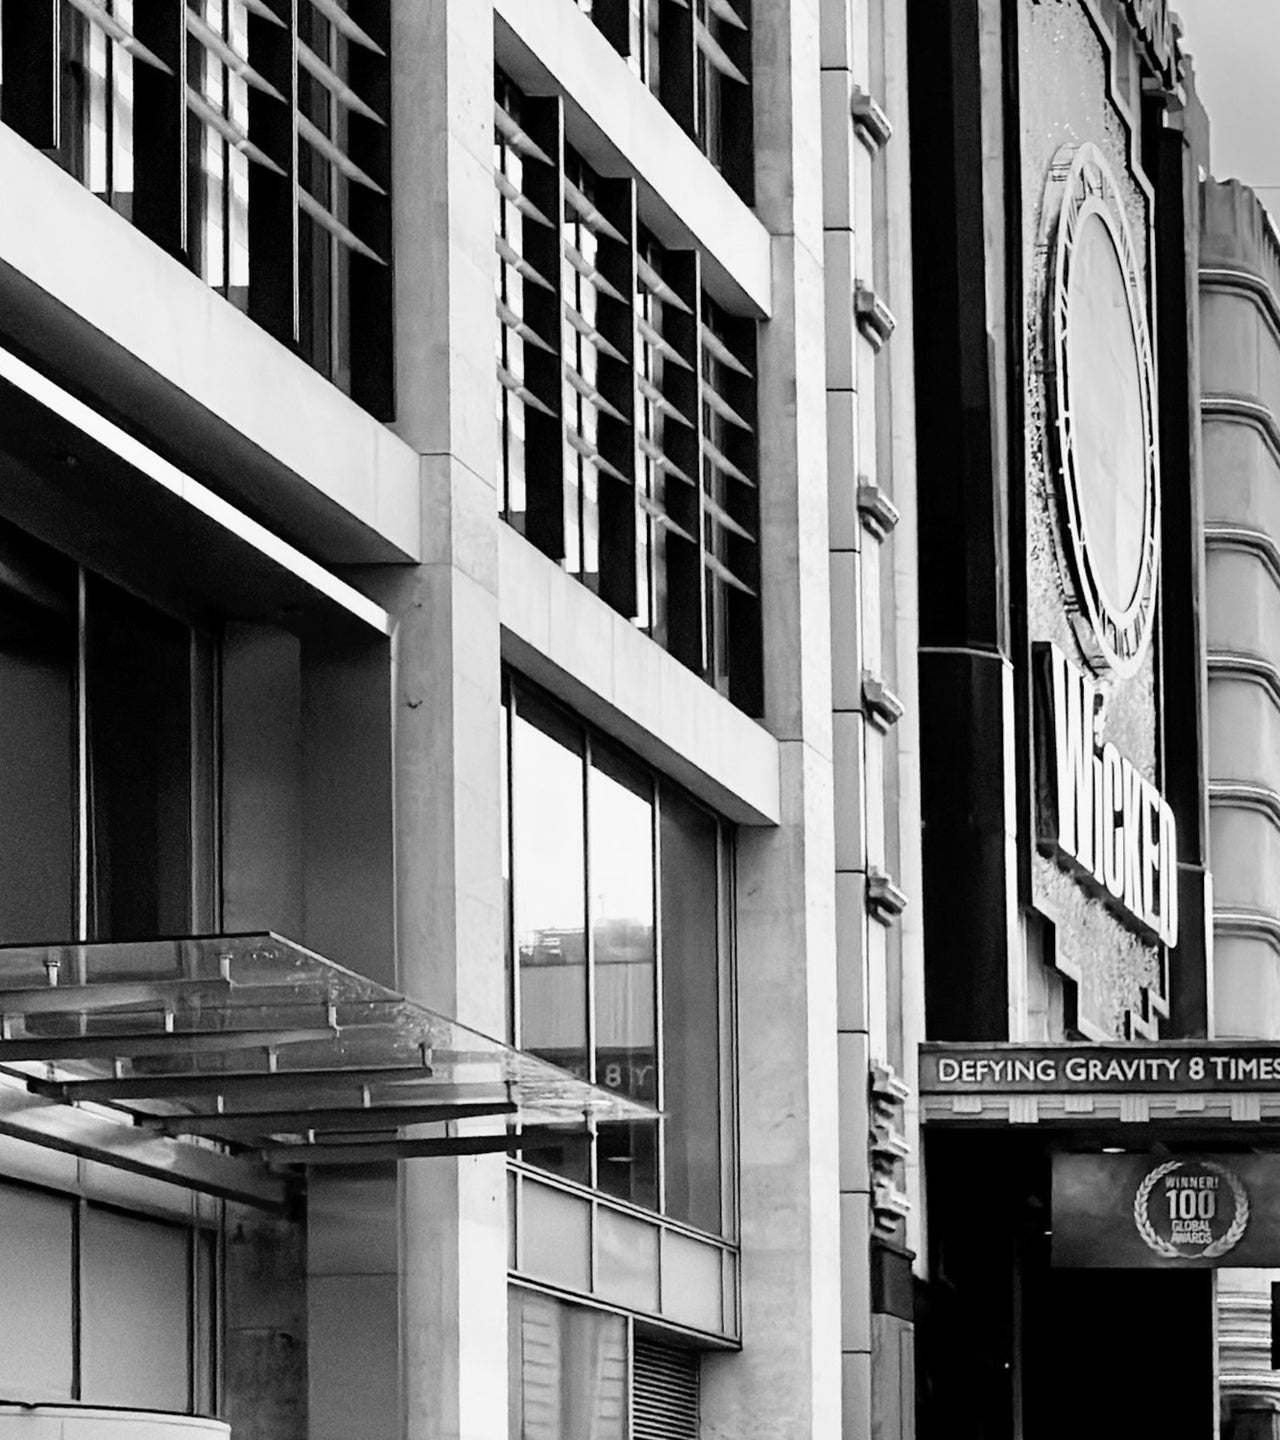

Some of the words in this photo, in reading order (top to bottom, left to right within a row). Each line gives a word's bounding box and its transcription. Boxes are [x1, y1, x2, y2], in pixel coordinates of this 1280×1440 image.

[938, 1058, 1056, 1082] DEFYING
[1065, 1057, 1181, 1081] GRAVITY
[1188, 1057, 1205, 1080] 8
[1165, 1176, 1219, 1189] WINNER!
[1165, 1189, 1215, 1219] 100
